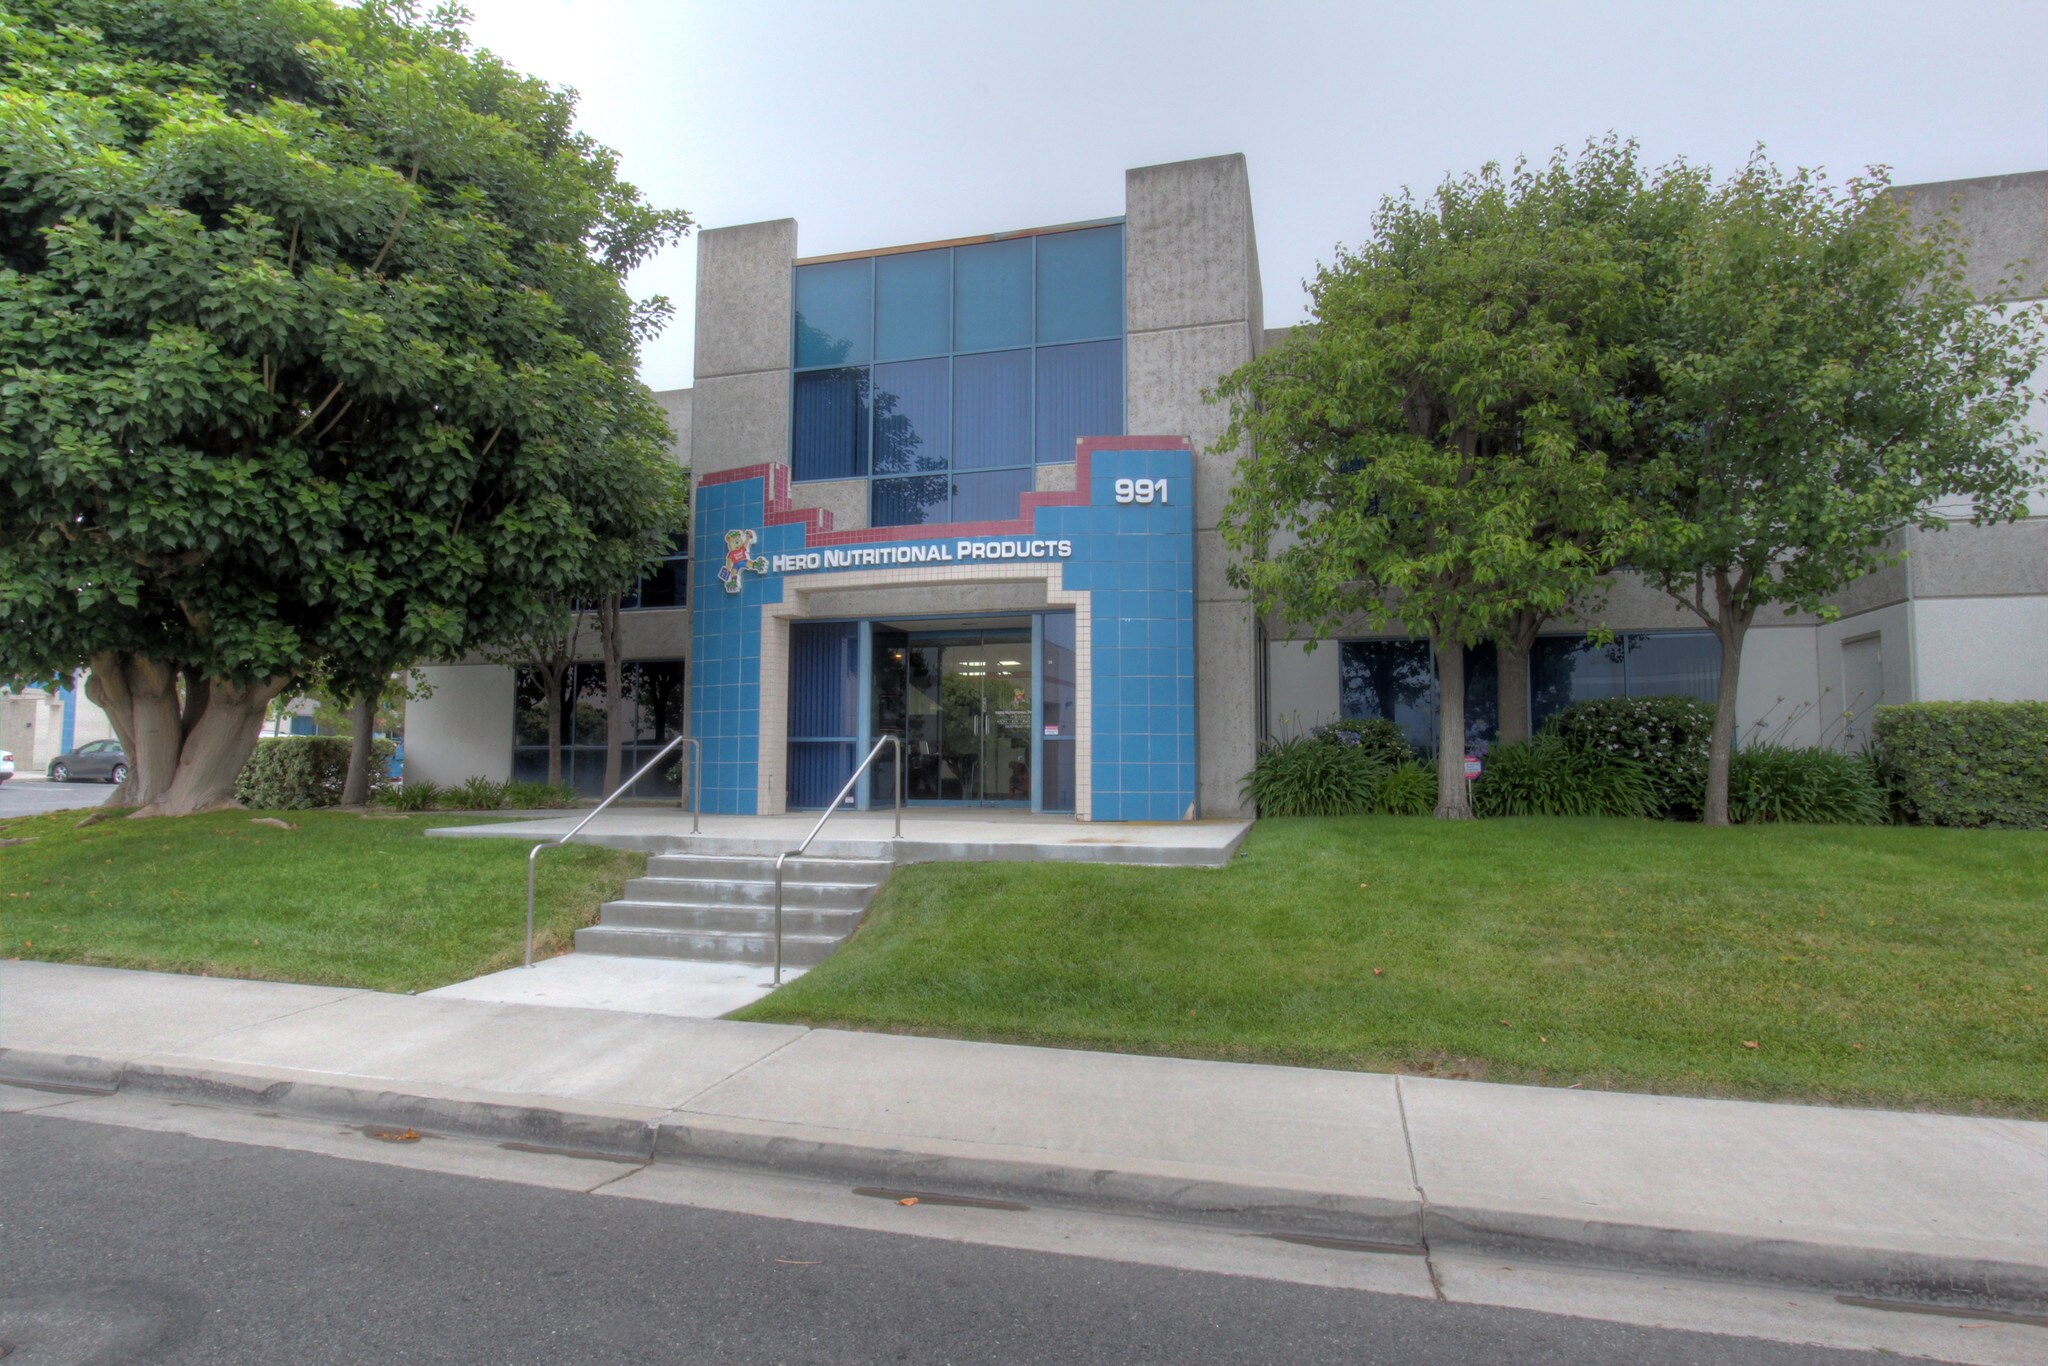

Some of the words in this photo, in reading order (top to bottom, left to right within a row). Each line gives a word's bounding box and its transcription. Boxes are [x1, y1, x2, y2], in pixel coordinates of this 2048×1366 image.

[1114, 478, 1169, 503] 991
[772, 553, 820, 572] HERO
[823, 544, 953, 568] NUTRITIONAL
[957, 539, 1073, 560] PRODUCTS
